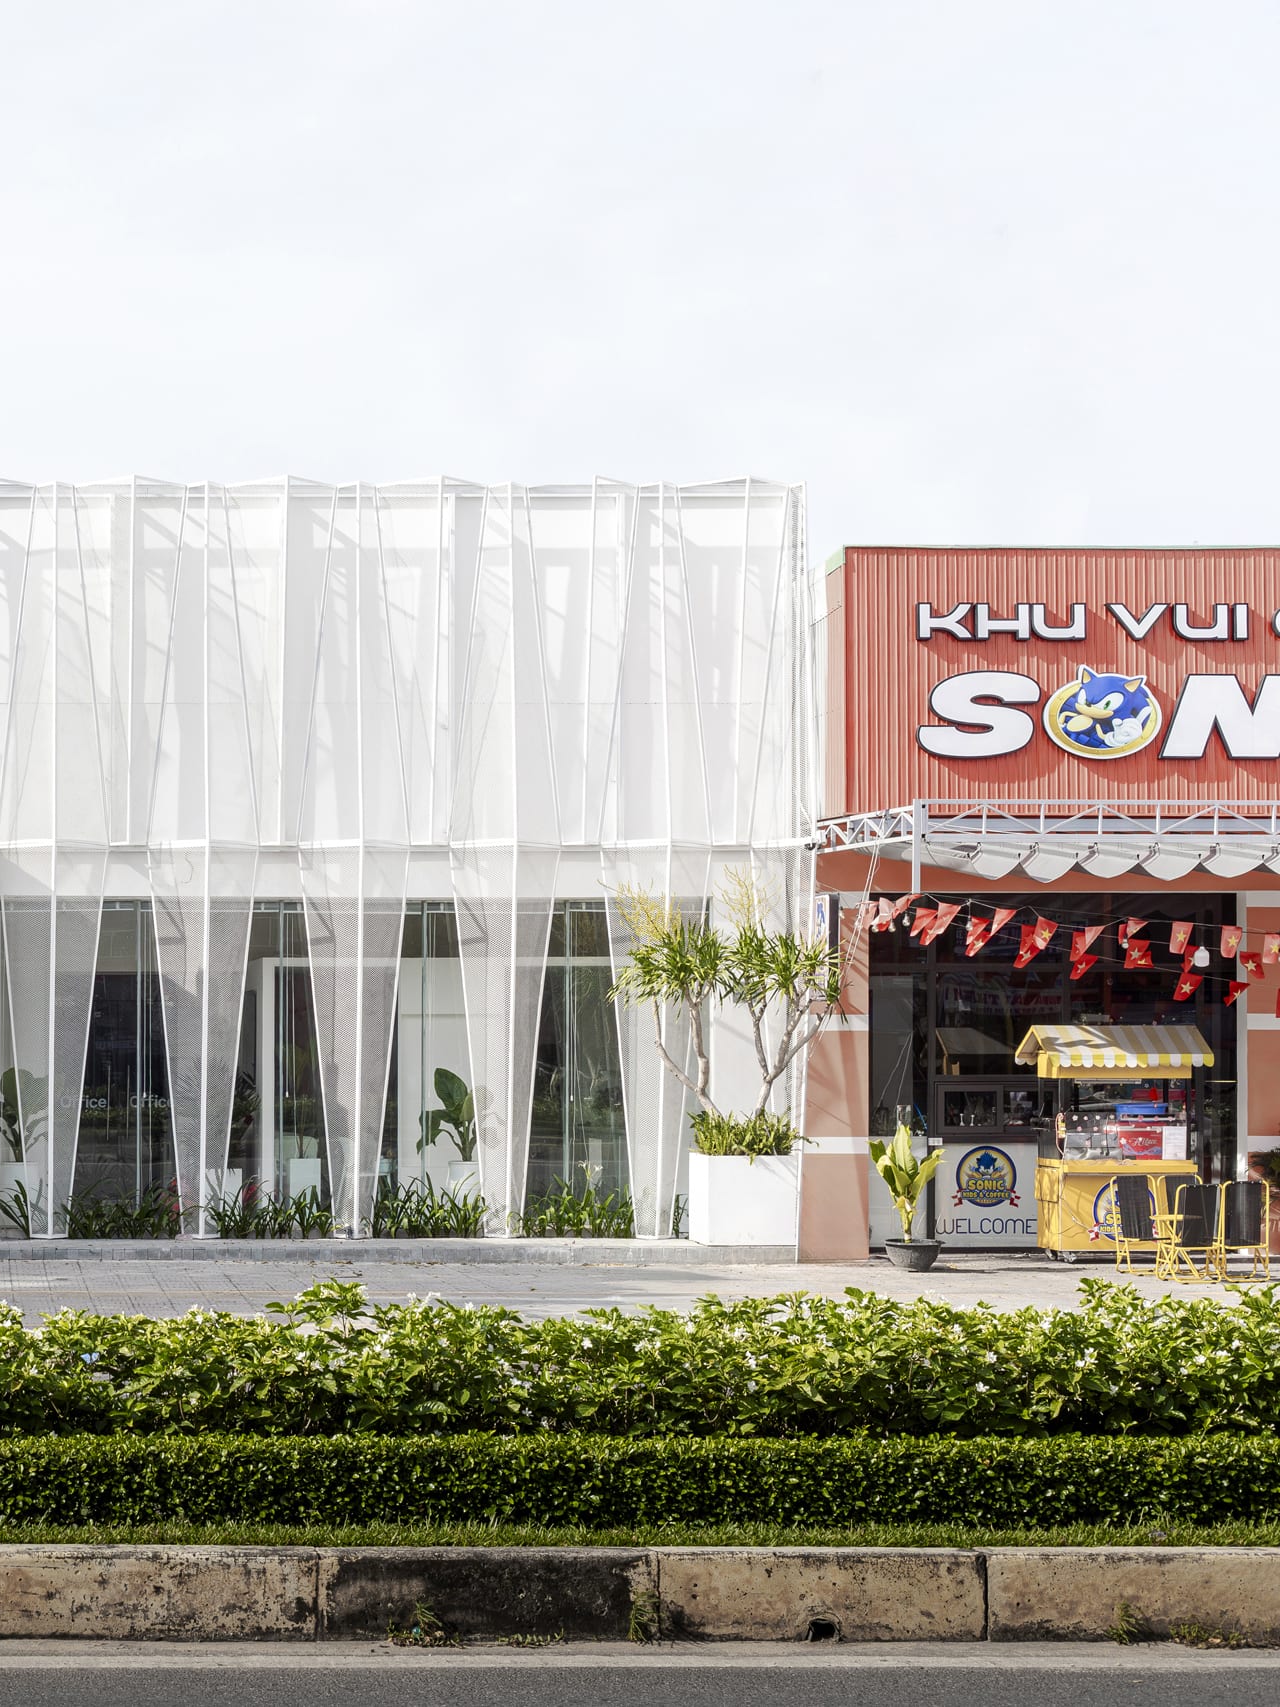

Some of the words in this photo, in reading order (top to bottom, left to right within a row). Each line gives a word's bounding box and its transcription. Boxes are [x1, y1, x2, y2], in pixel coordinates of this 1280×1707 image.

[916, 602, 1087, 641] KHU
[1104, 602, 1249, 641] VUI
[130, 1094, 172, 1109] Offic
[968, 1179, 1005, 1190] SONIC
[985, 1191, 1009, 1199] COFFEE
[936, 1218, 1037, 1235] WELCOME
